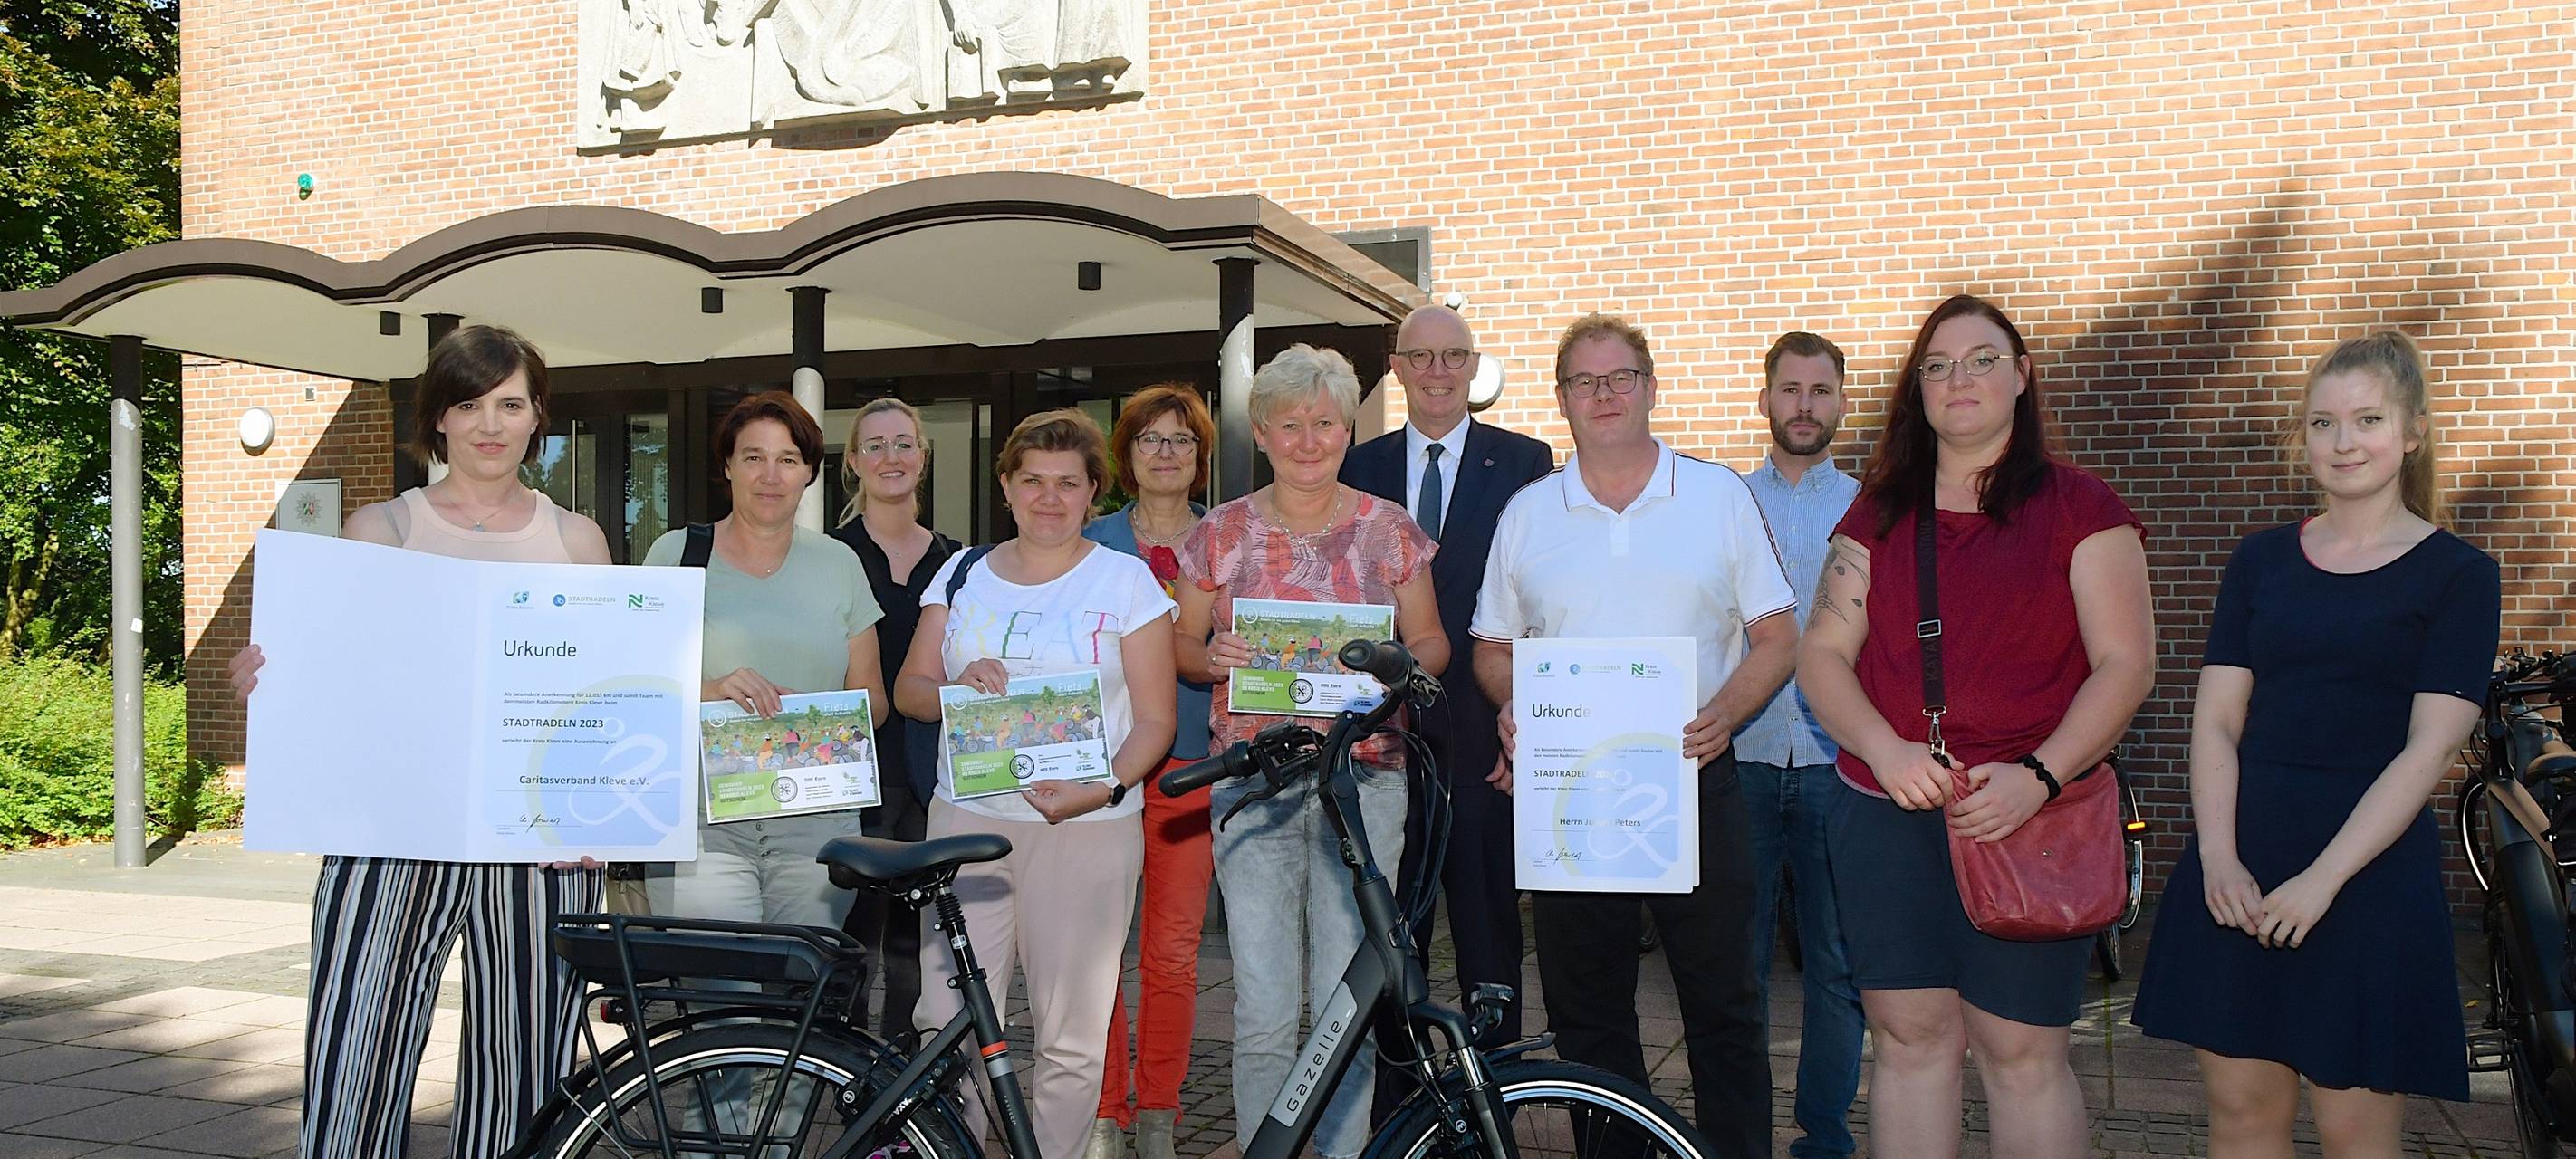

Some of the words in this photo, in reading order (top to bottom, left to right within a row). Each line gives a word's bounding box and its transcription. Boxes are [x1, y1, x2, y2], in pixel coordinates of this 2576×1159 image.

[504, 640, 577, 657] Urkunde
[1532, 704, 1590, 718] Urkunde
[503, 718, 576, 728] STADTRADELN
[580, 719, 604, 728] 2023
[519, 775, 596, 785] Caritasverband
[599, 776, 627, 785] Kleve
[630, 777, 649, 786] e.V.
[1287, 1020, 1343, 1112] Gazelle
